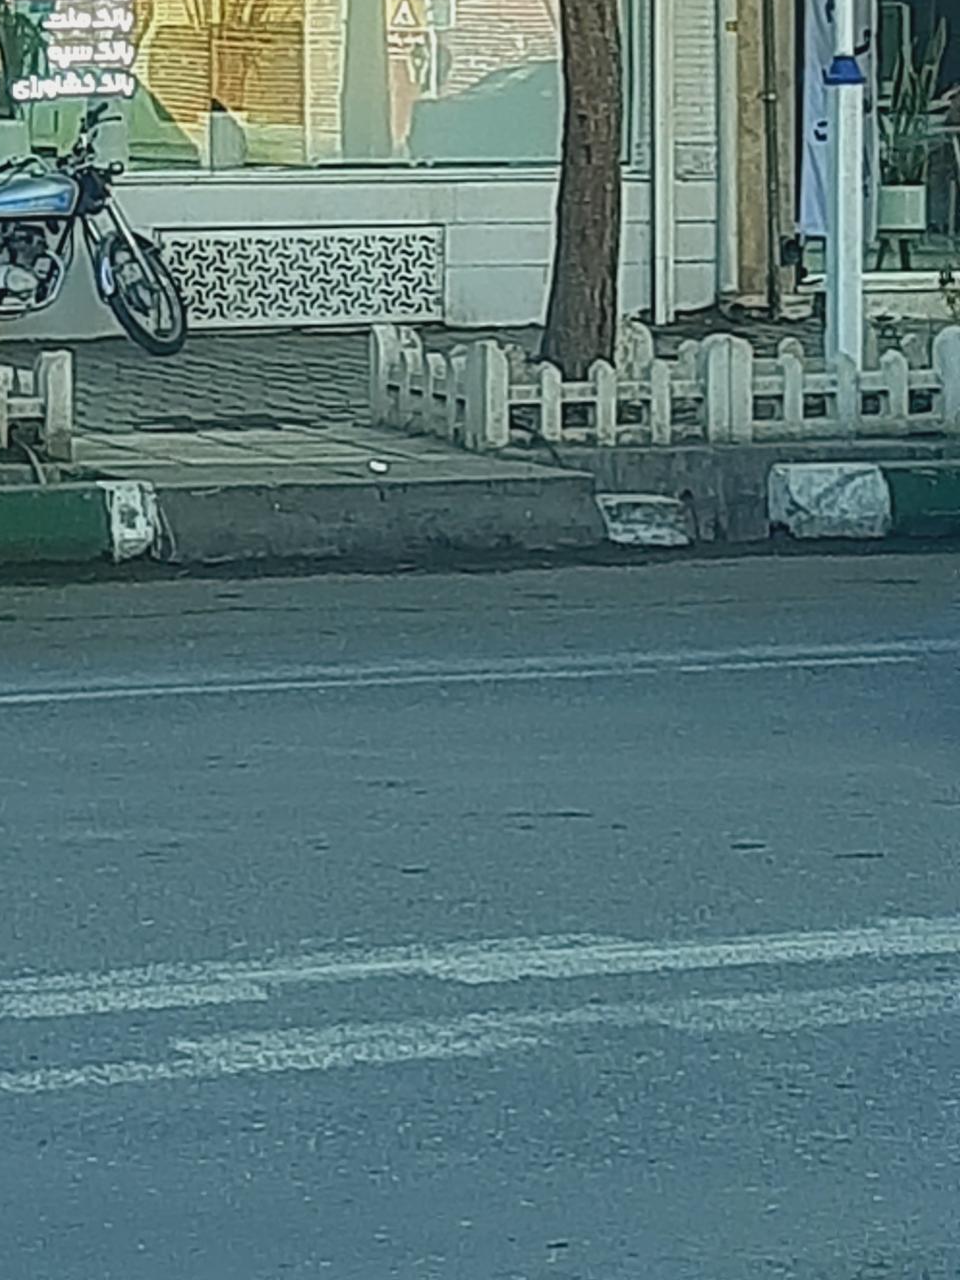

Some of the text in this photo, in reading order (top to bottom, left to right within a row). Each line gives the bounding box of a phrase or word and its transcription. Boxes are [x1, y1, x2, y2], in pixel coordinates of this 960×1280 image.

[92, 7, 133, 32] بانک
[93, 40, 134, 65] بانک
[96, 73, 134, 96] بانک
